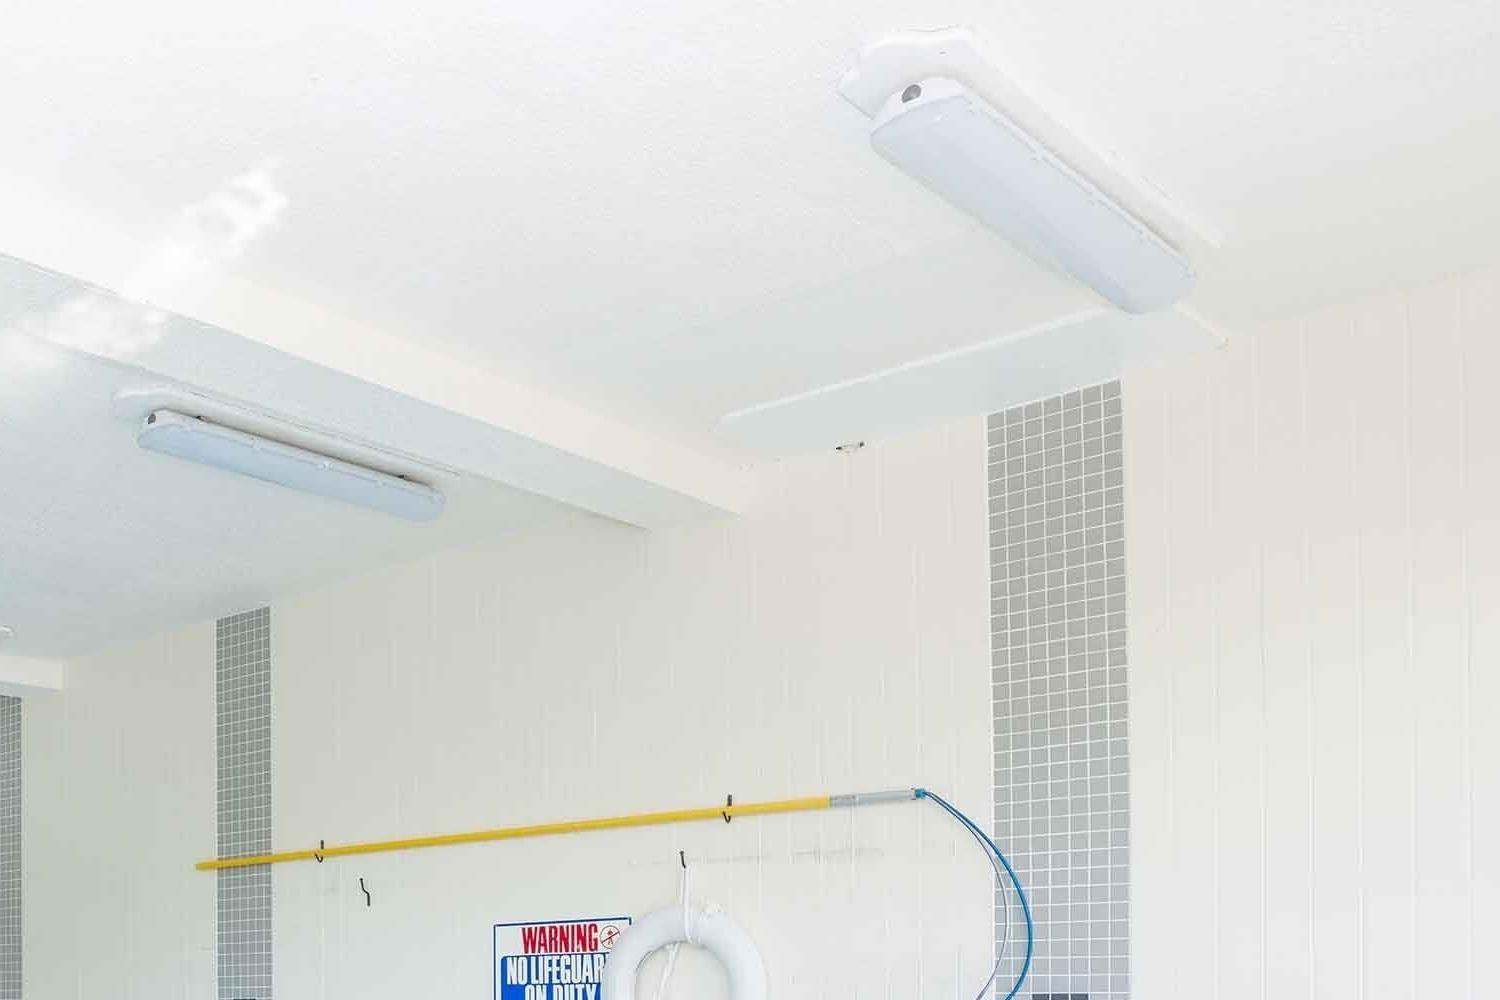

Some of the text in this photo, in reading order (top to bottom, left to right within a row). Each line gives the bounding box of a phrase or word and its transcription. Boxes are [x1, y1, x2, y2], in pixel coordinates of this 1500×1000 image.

[521, 923, 599, 954] WARNING
[507, 954, 607, 985] NO LIFEGUAR
